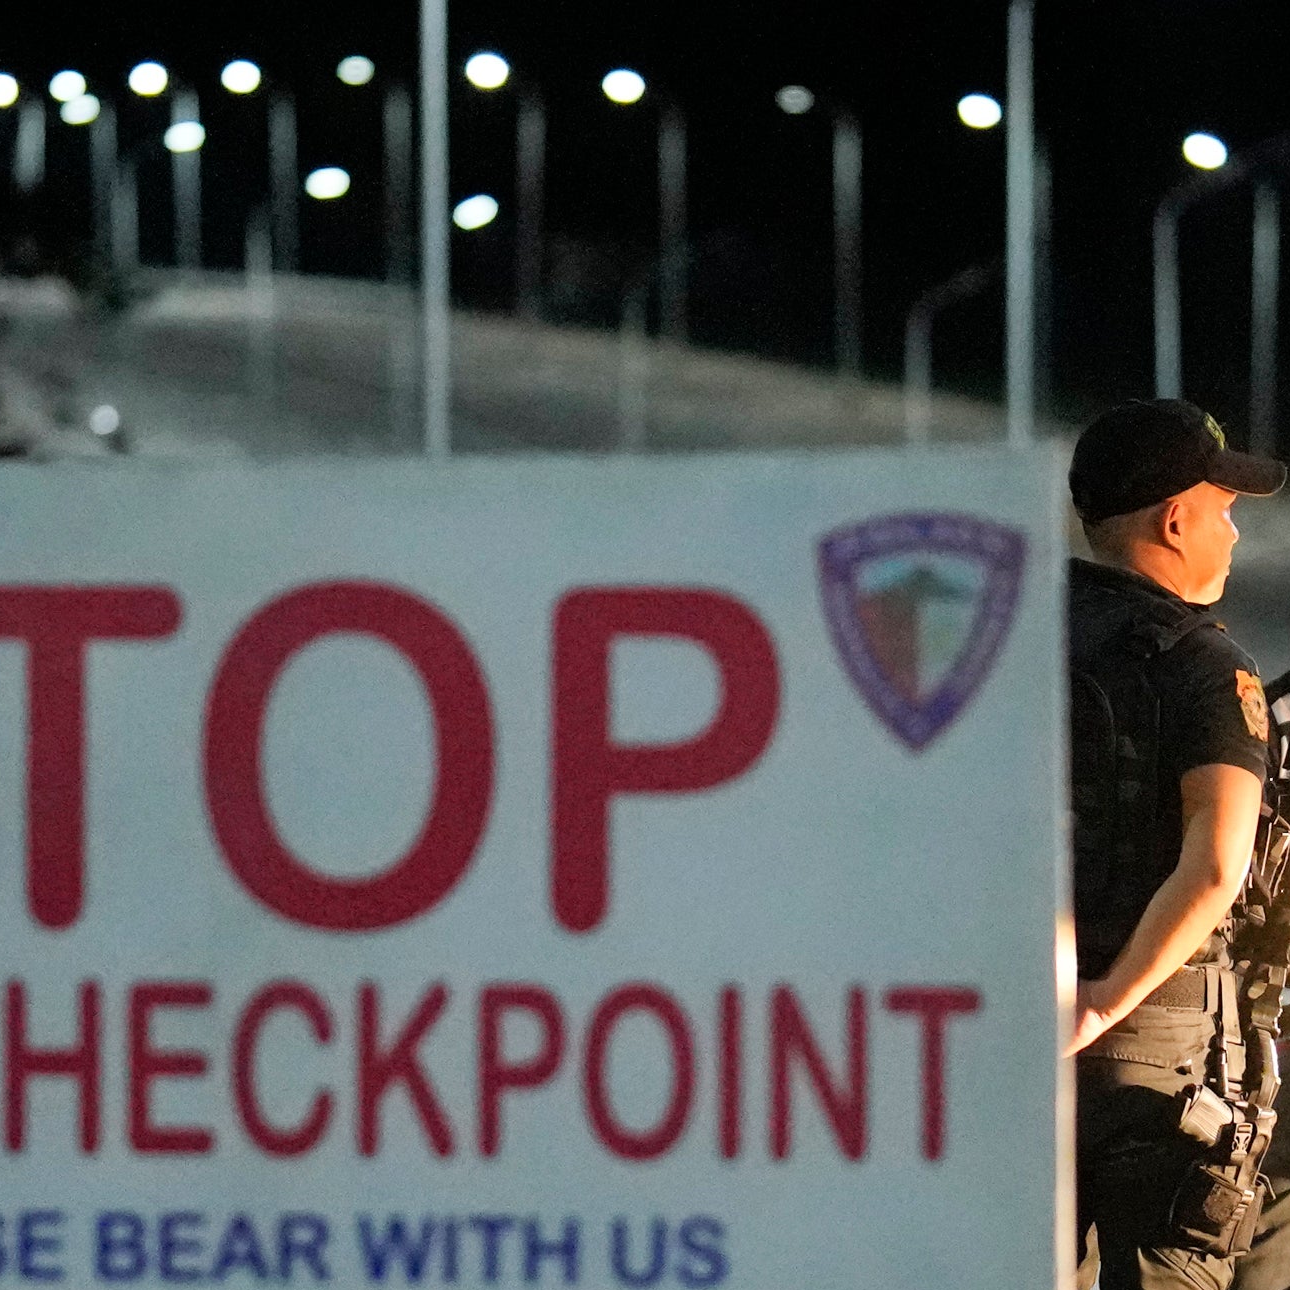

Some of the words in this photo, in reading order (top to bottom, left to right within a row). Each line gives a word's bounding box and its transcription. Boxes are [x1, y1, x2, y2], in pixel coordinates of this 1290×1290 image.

[92, 1210, 333, 1286] BEAR
[356, 1213, 582, 1287] WITH
[608, 1216, 730, 1290] US
